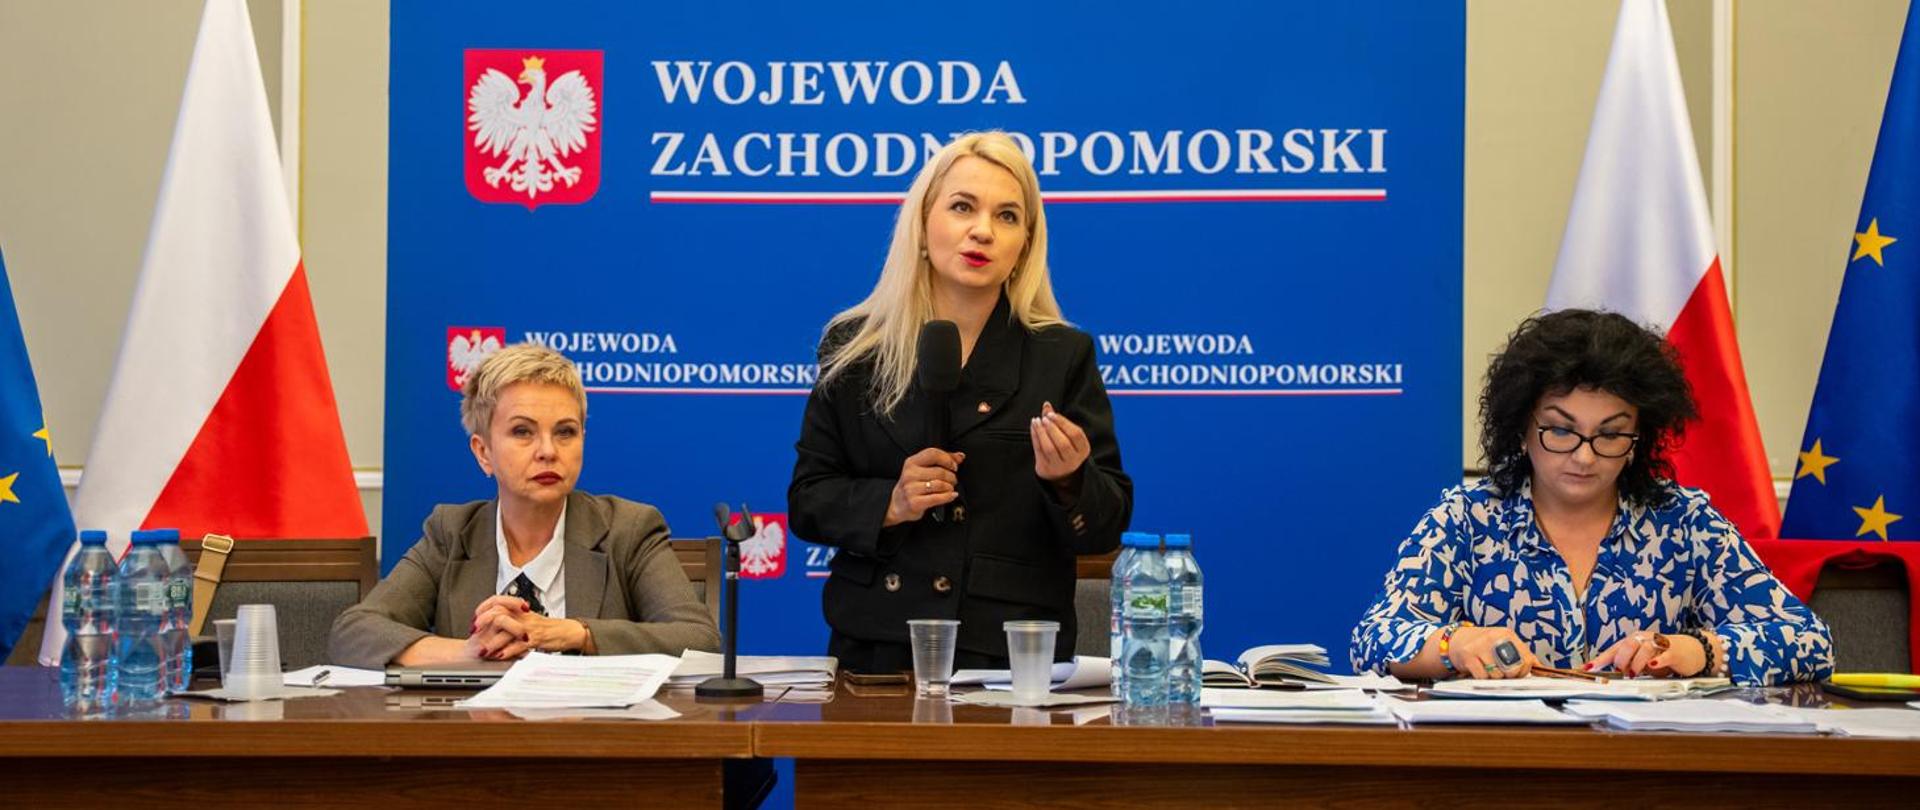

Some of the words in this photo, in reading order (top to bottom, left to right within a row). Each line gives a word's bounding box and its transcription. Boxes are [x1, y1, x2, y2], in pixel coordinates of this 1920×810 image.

[650, 60, 1027, 105] WOJEWODA
[650, 128, 1388, 177] ZACHODPOMORSKI
[524, 331, 678, 353] WOJEWODA
[1098, 334, 1254, 355] WOJEWODA
[577, 361, 821, 385] HODNIOPOMORSK
[1098, 364, 1403, 385] ZACHODNIOPOMORSKI
